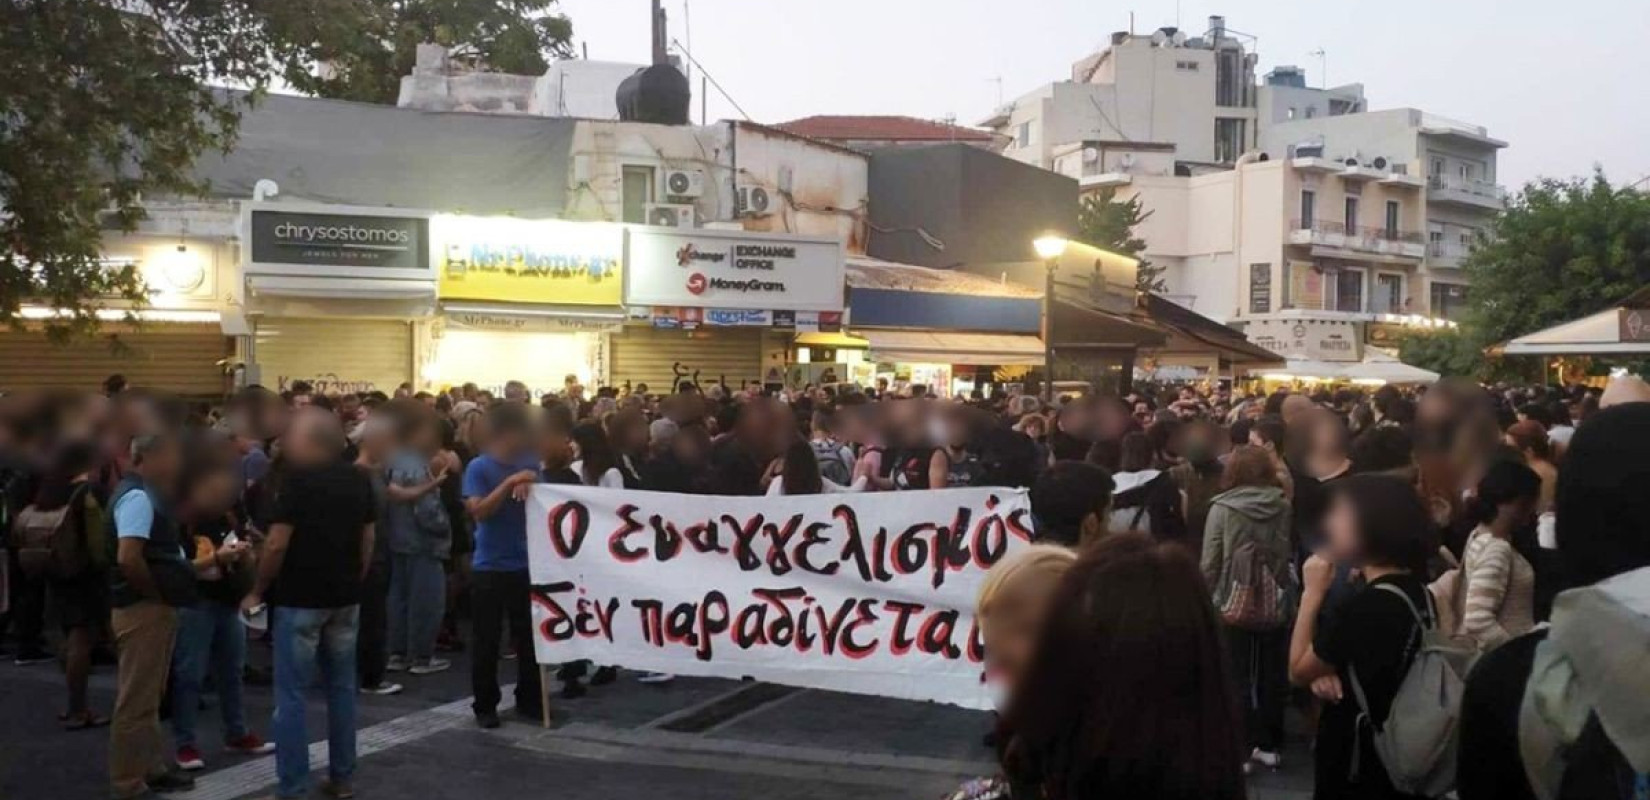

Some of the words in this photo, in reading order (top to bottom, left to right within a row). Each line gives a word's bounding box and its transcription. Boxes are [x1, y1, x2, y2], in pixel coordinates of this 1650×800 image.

[274, 222, 408, 242] chrysostomos
[736, 245, 796, 258] EXCHANGE
[736, 259, 774, 270] OFFICE
